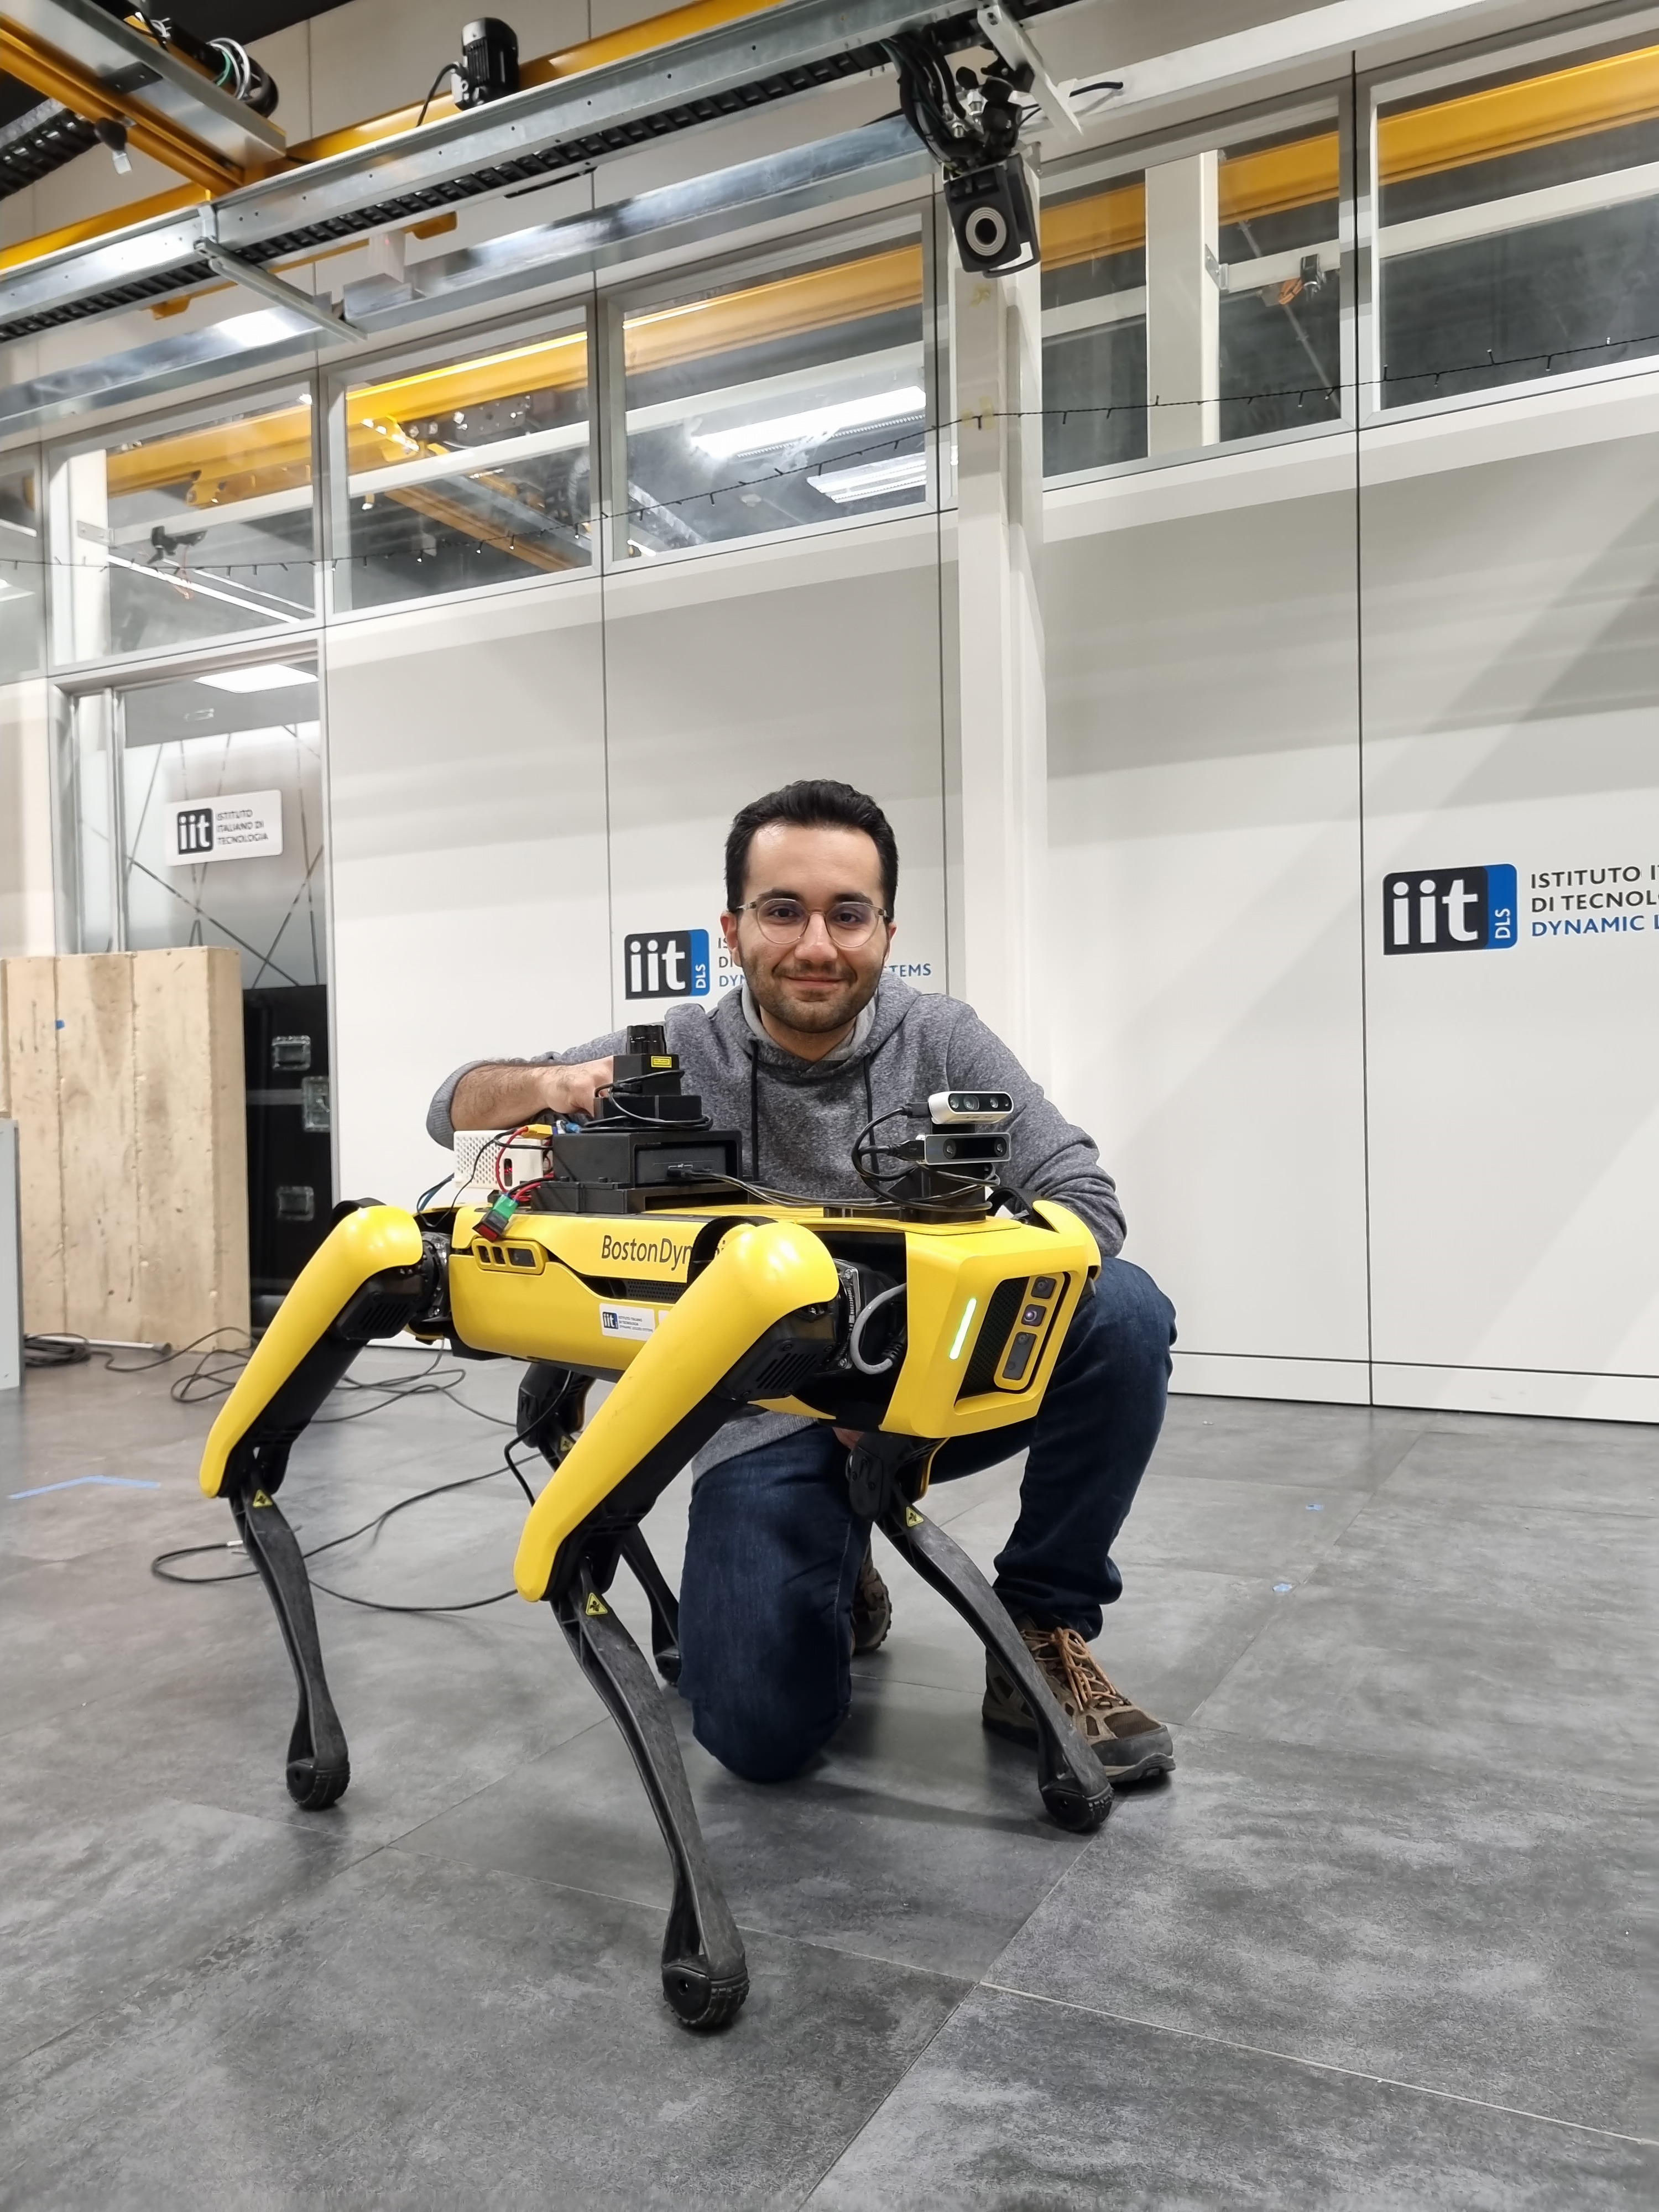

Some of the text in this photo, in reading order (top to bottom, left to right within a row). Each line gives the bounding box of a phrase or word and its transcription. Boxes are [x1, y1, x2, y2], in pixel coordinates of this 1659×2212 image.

[179, 813, 210, 850] iit
[1531, 866, 1641, 889] ISTITUTO
[1393, 879, 1479, 946] iit
[1532, 890, 1659, 912] DI TECNOL
[1494, 908, 1511, 940] DLS
[1532, 915, 1645, 937] DYNAMIC
[629, 939, 686, 993] iit
[696, 964, 707, 989] DLS
[888, 963, 932, 977] TEMS
[602, 1235, 693, 1271] BostonDyn
[603, 1312, 615, 1328] iit
